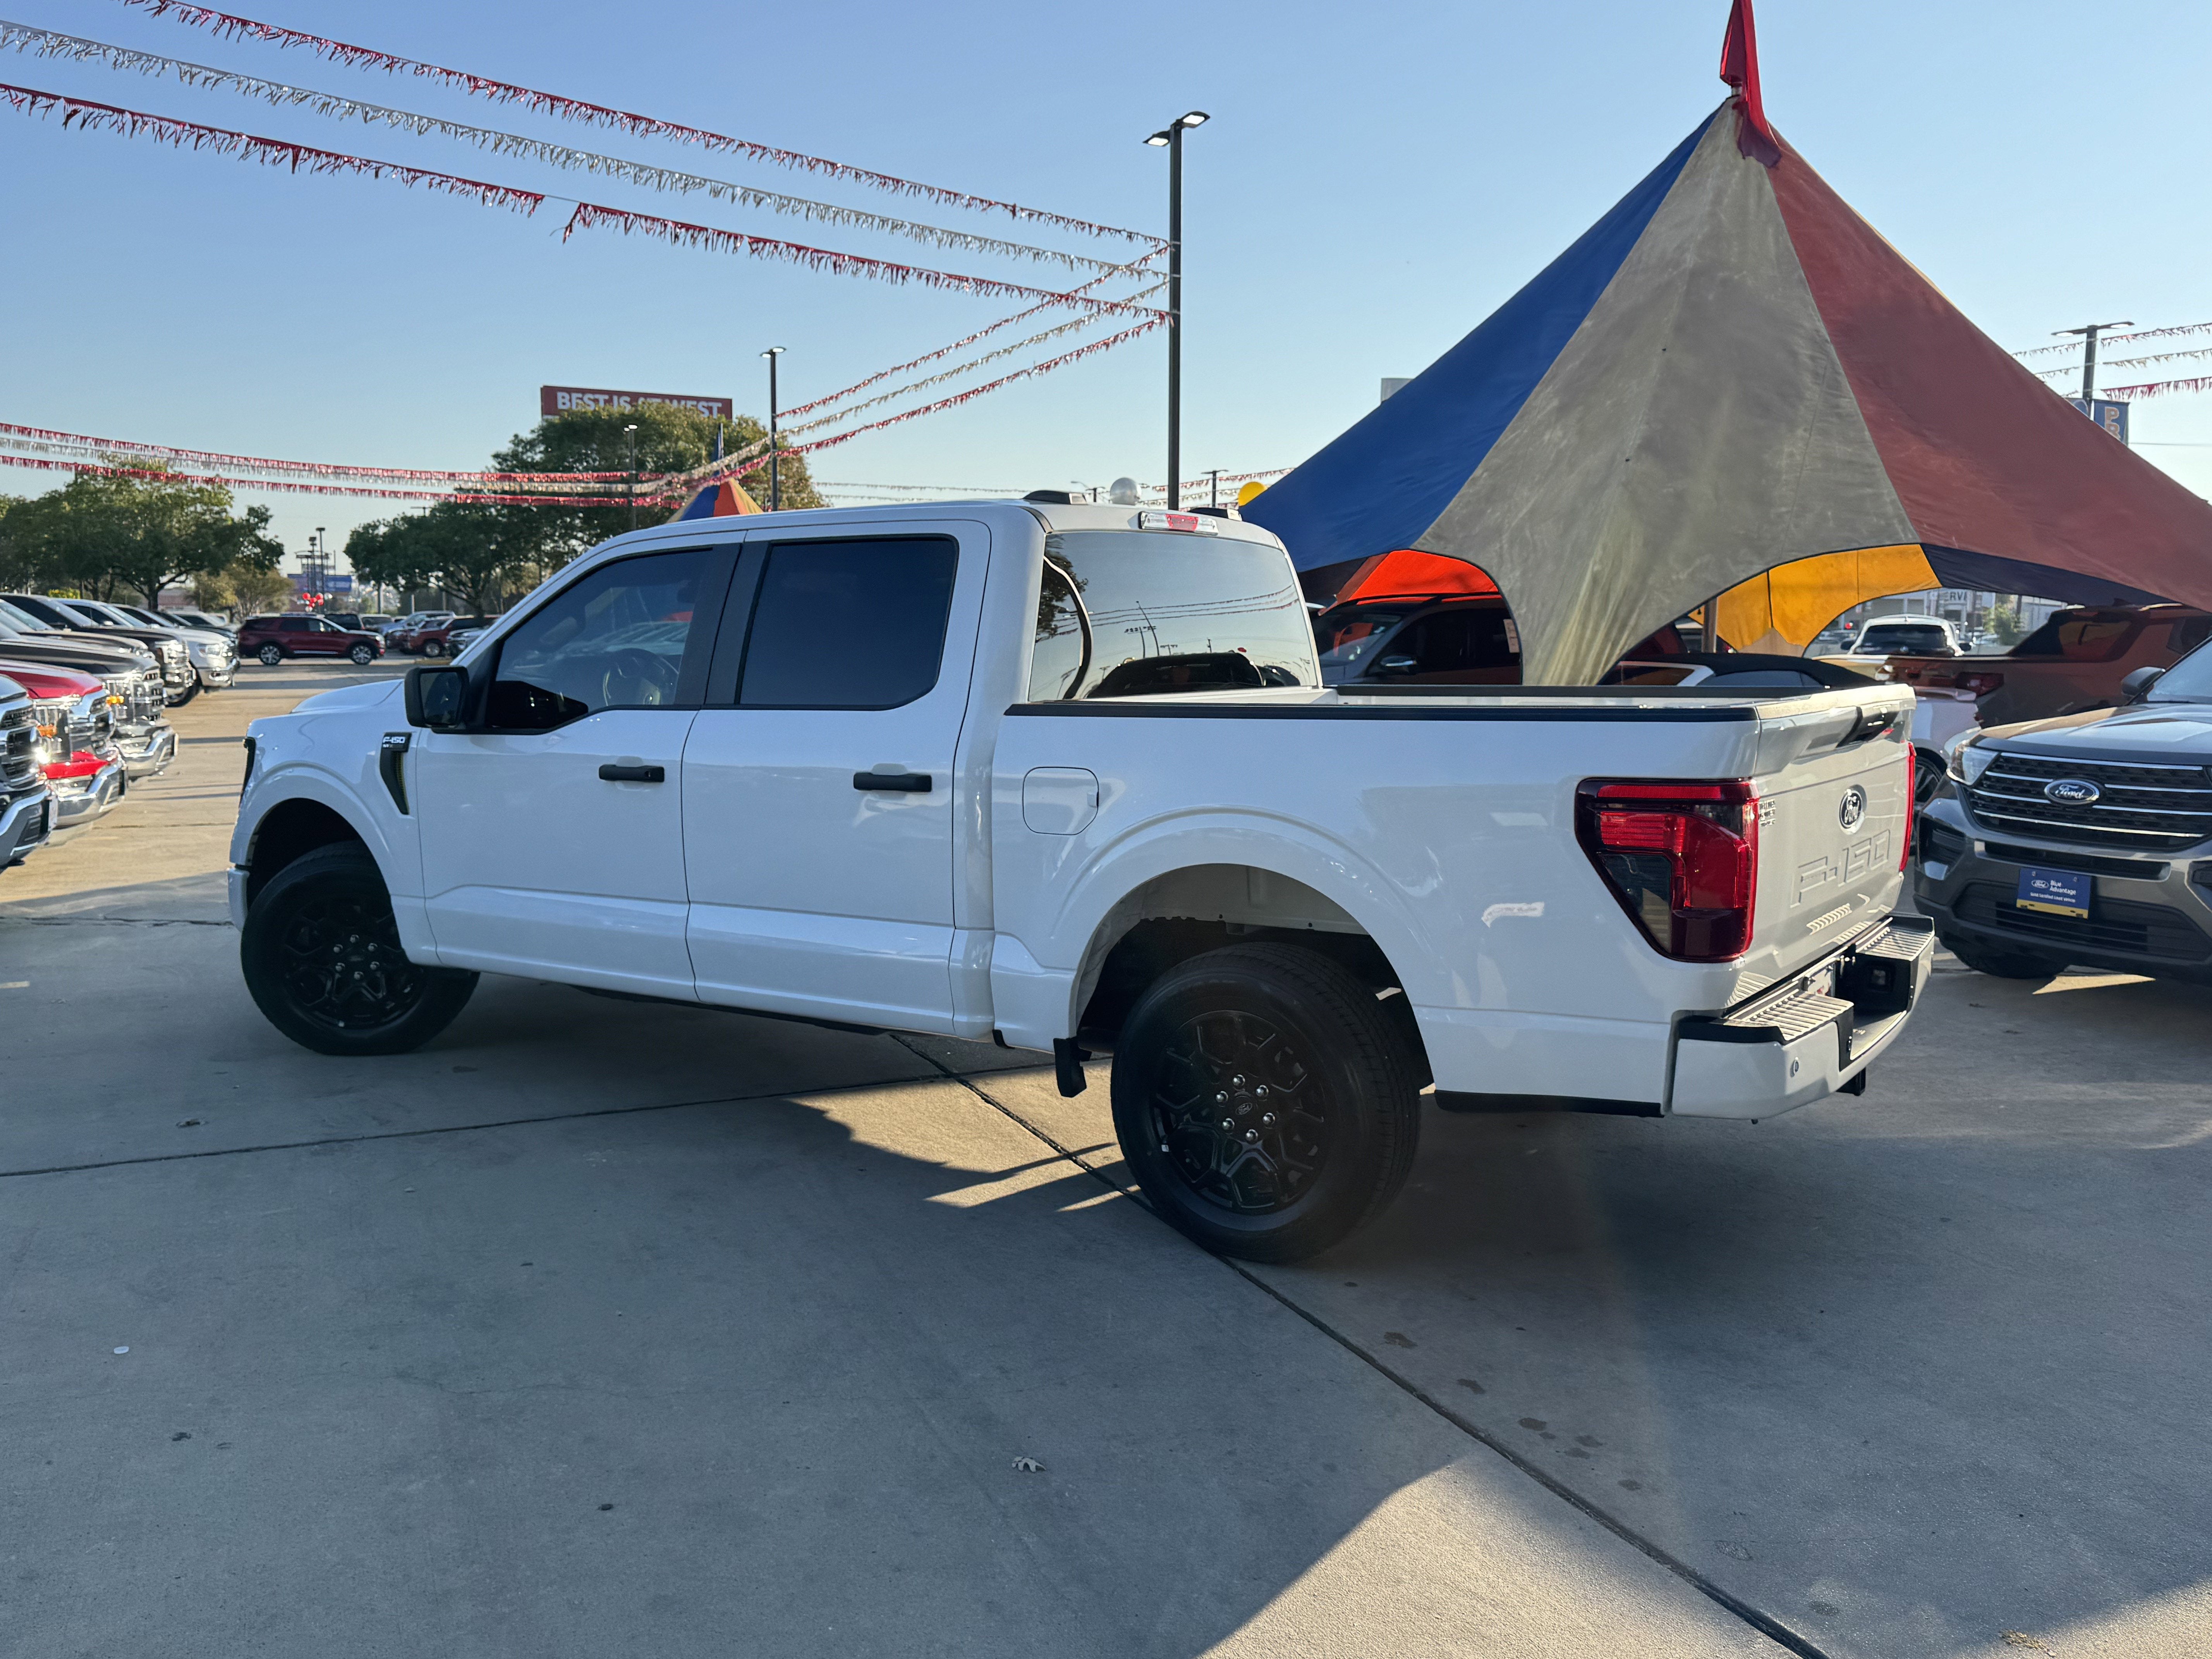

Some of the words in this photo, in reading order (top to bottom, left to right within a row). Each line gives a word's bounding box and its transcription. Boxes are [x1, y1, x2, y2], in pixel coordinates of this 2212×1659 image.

[556, 392, 609, 411] BEST
[613, 395, 632, 413] IS
[2055, 784, 2085, 799] Ford
[1790, 829, 1891, 908] F-150
[2049, 886, 2076, 896] Advantage
